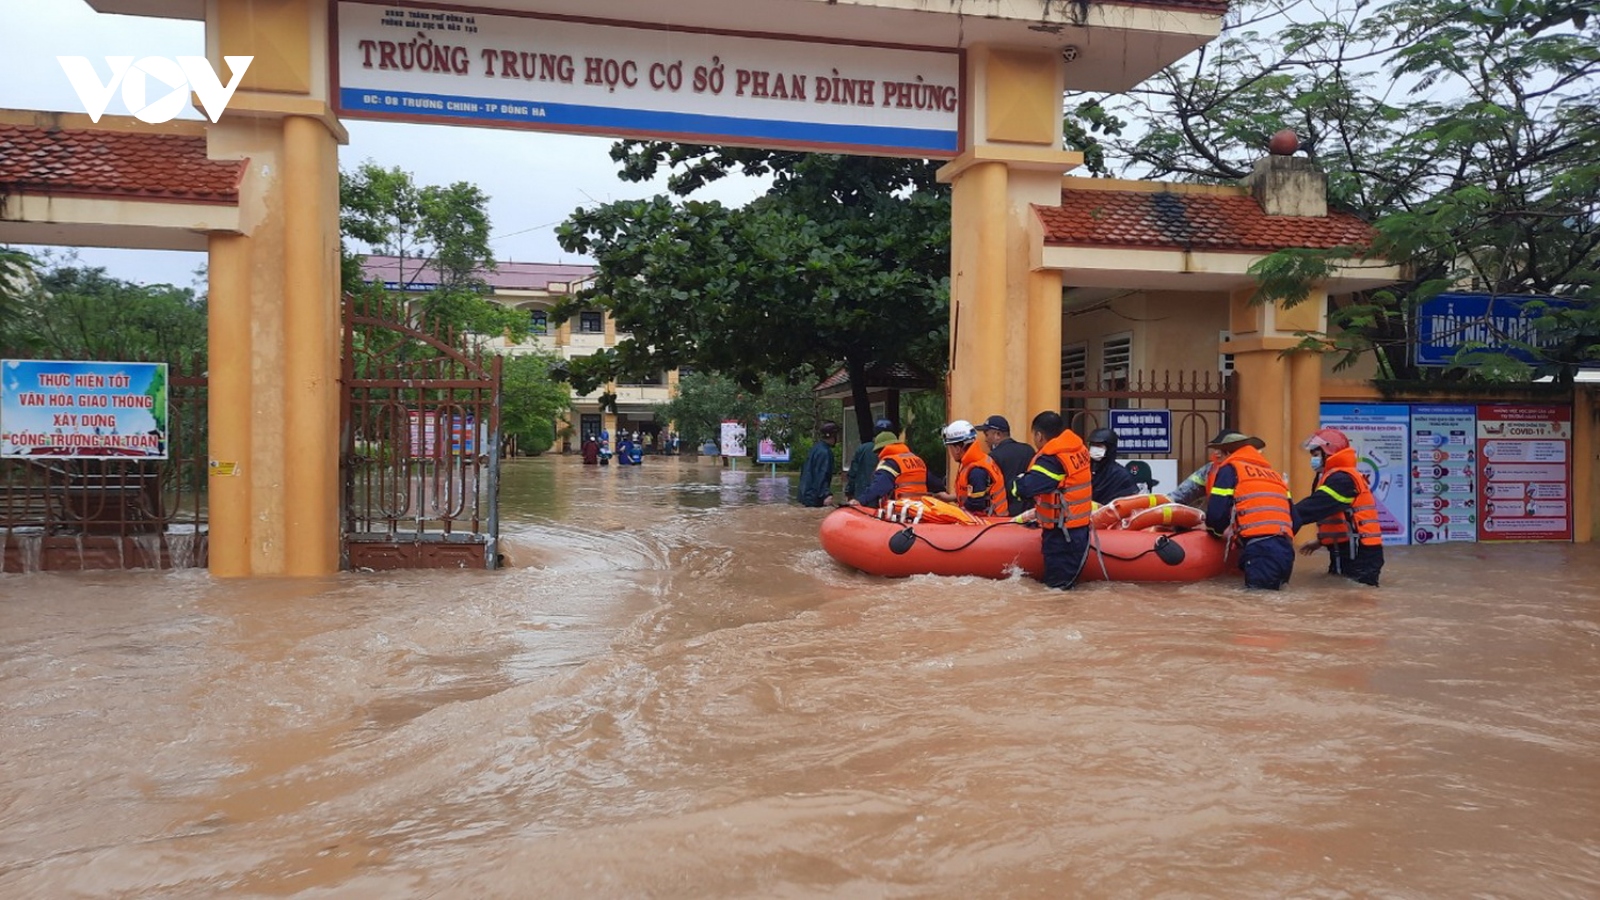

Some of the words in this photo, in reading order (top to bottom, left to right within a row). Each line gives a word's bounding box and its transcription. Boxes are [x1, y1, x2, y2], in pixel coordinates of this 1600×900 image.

[359, 31, 470, 74] TRƯỜNG
[481, 48, 575, 82] TRUNG
[584, 57, 638, 93] HỌC
[649, 60, 683, 91] CƠ
[693, 55, 724, 95] SỞ
[736, 69, 807, 100] PHAN
[815, 67, 876, 107] ĐÌNH
[882, 74, 957, 112] PHÙNG
[385, 96, 399, 105] 08
[39, 374, 71, 389] THỰC
[75, 373, 104, 390] HIỆN
[108, 371, 130, 388] TỐT
[19, 392, 45, 406] VĂN
[78, 395, 107, 407] GIAO
[112, 394, 153, 408] THÔNG
[53, 412, 77, 426] XÂY
[82, 413, 115, 428] DỰNG
[11, 433, 45, 446] CÔNG
[103, 434, 122, 446] AN
[126, 432, 157, 447] TOÀN
